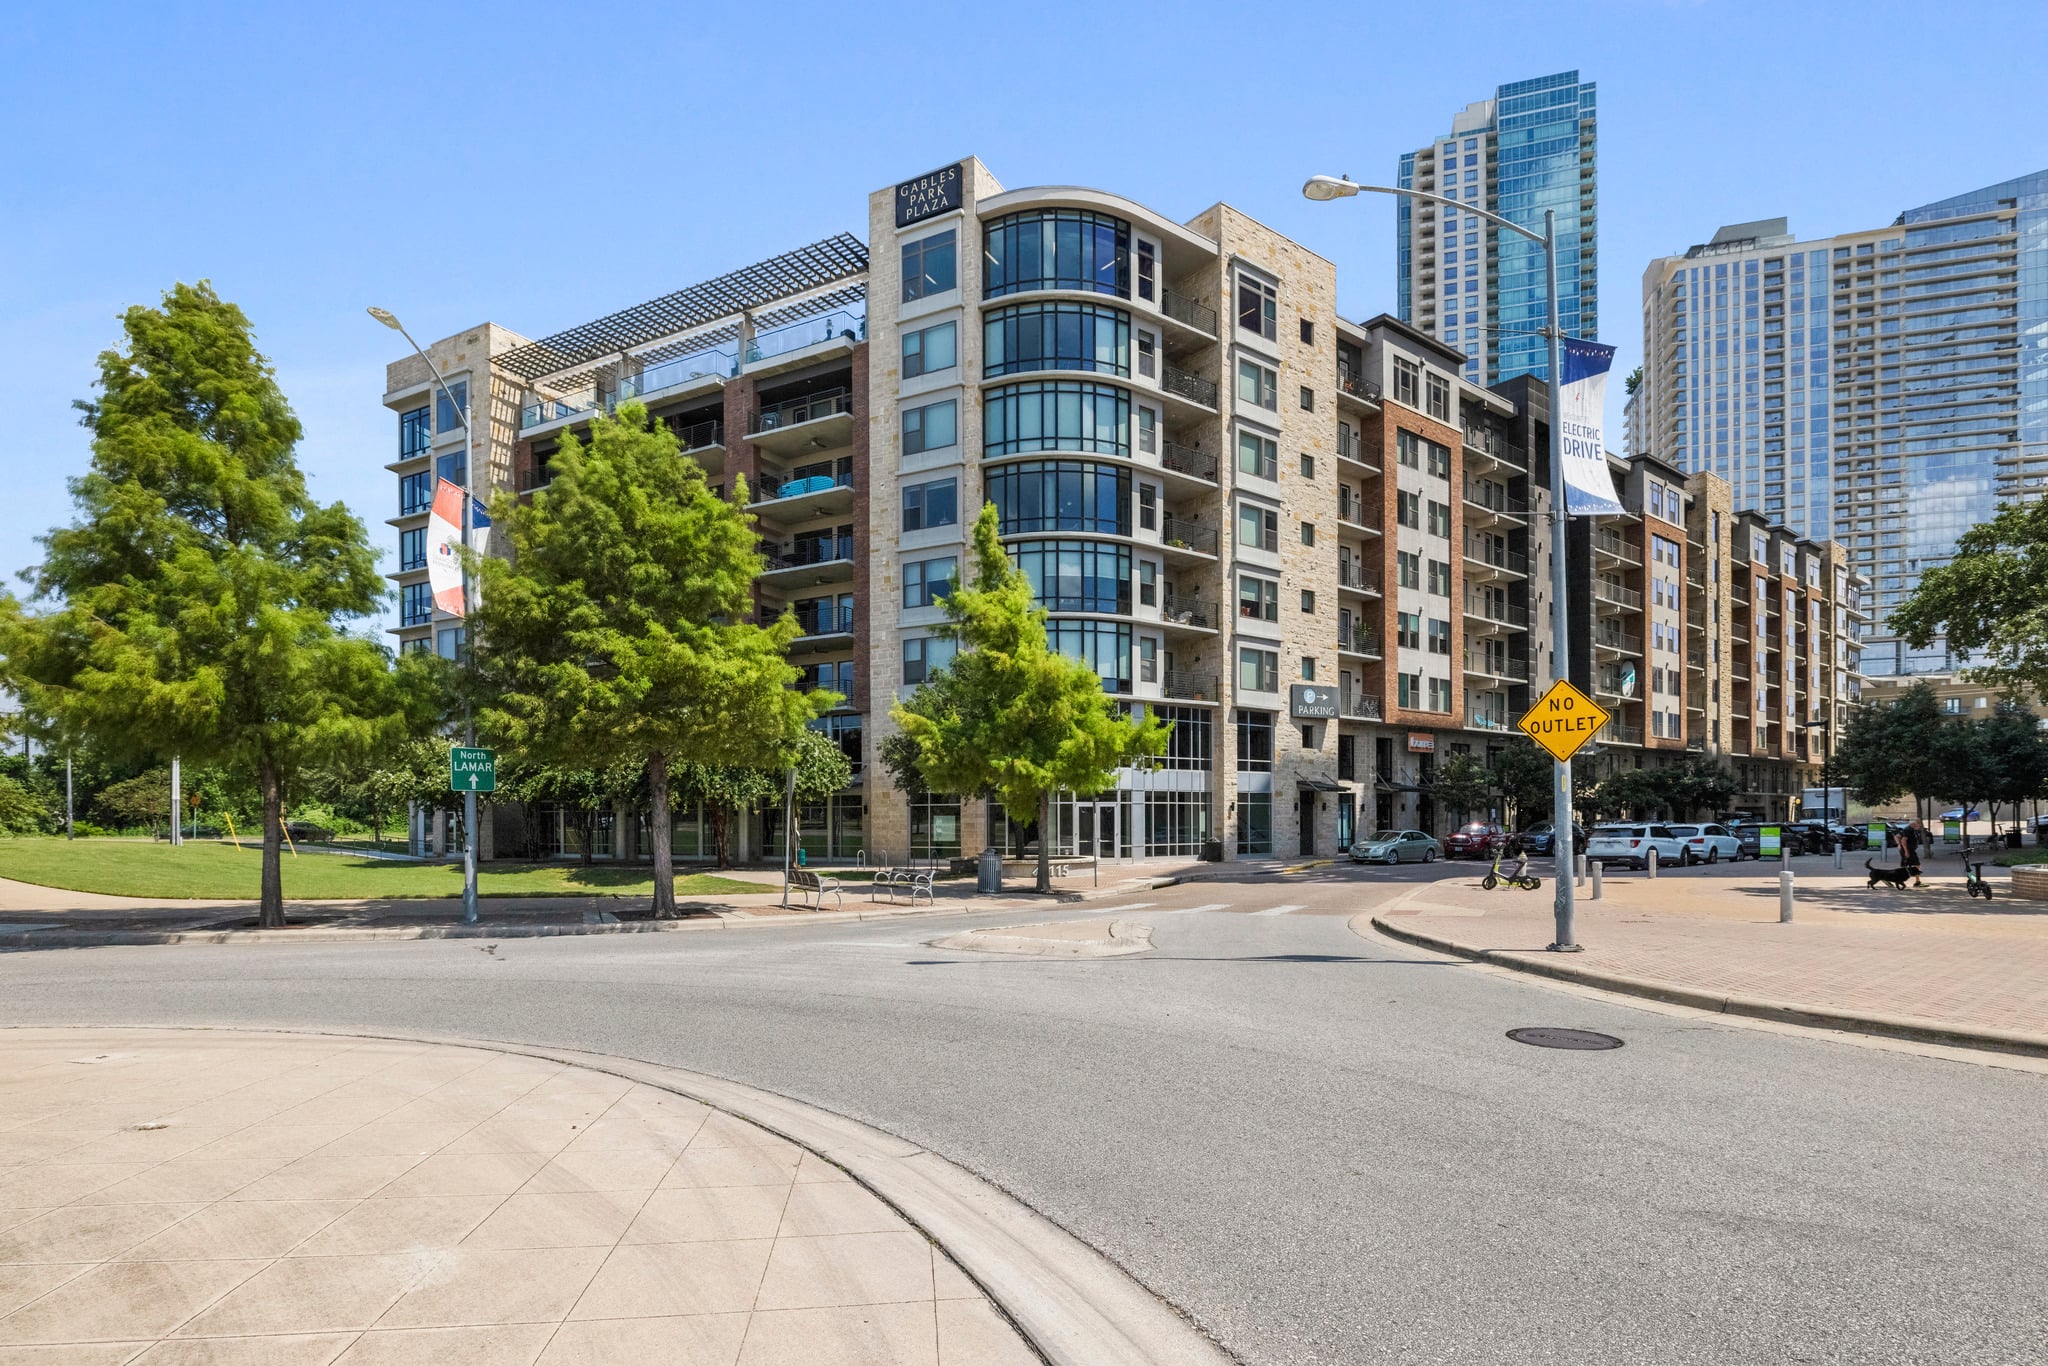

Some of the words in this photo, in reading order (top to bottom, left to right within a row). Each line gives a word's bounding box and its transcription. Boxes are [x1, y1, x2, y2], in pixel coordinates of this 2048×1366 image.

[901, 168, 955, 197] GABLES
[910, 184, 944, 206] PARK
[906, 196, 949, 220] PLAZA
[1562, 421, 1601, 441] ELECTRIC
[1563, 436, 1603, 461] DRIVE
[1298, 704, 1335, 716] PARKING
[1549, 697, 1574, 712] NO
[1530, 716, 1597, 735] OUTLET
[460, 750, 487, 760] North
[454, 761, 492, 772] LAMAR
